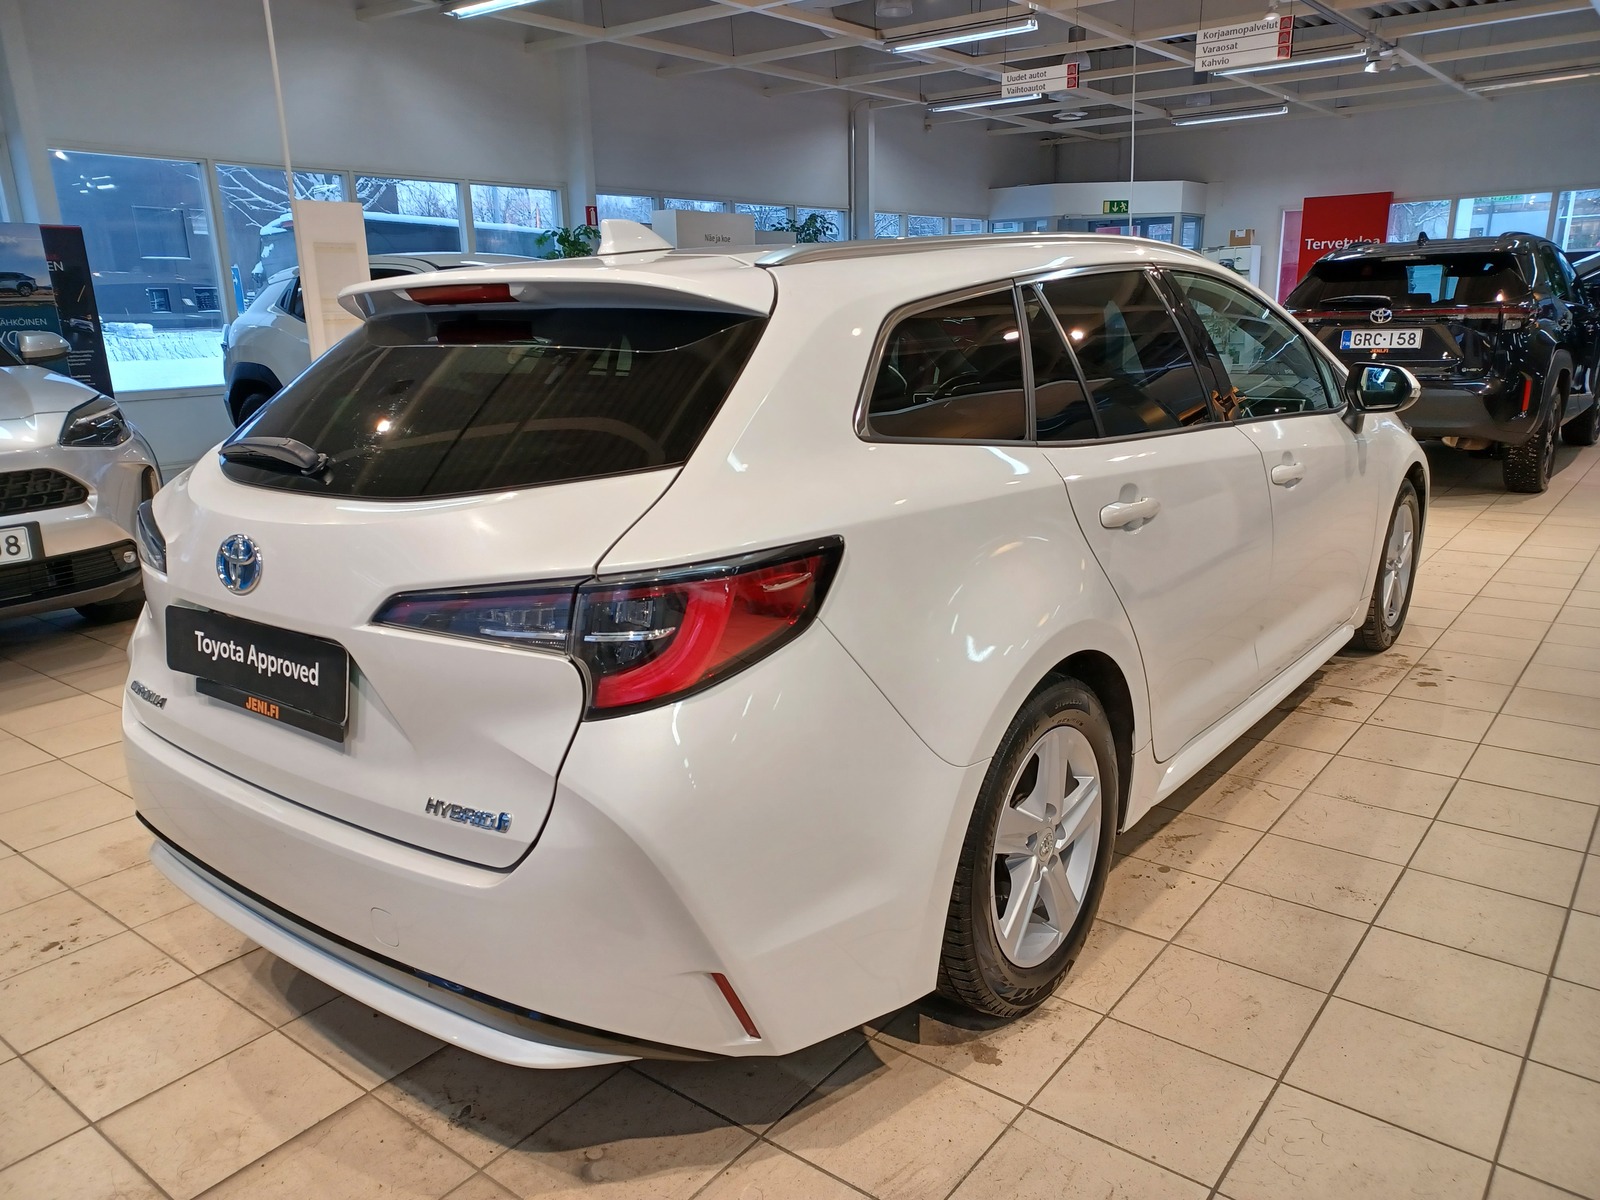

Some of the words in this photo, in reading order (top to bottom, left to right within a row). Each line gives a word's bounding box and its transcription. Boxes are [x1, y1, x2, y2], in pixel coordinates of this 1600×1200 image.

[1203, 21, 1278, 40] Korjaamopalvelut
[1202, 42, 1238, 54] Varaosat
[1201, 57, 1230, 68] Kahvio
[1006, 74, 1027, 82] Uudet
[1028, 71, 1047, 80] autot
[1006, 84, 1046, 95] Vaihtoautot
[721, 235, 731, 243] koe
[0, 534, 21, 557] 8
[194, 630, 244, 661] Toyota
[247, 644, 320, 687] Approved
[245, 696, 280, 720] JENI.FI
[425, 796, 497, 831] HYBRID
